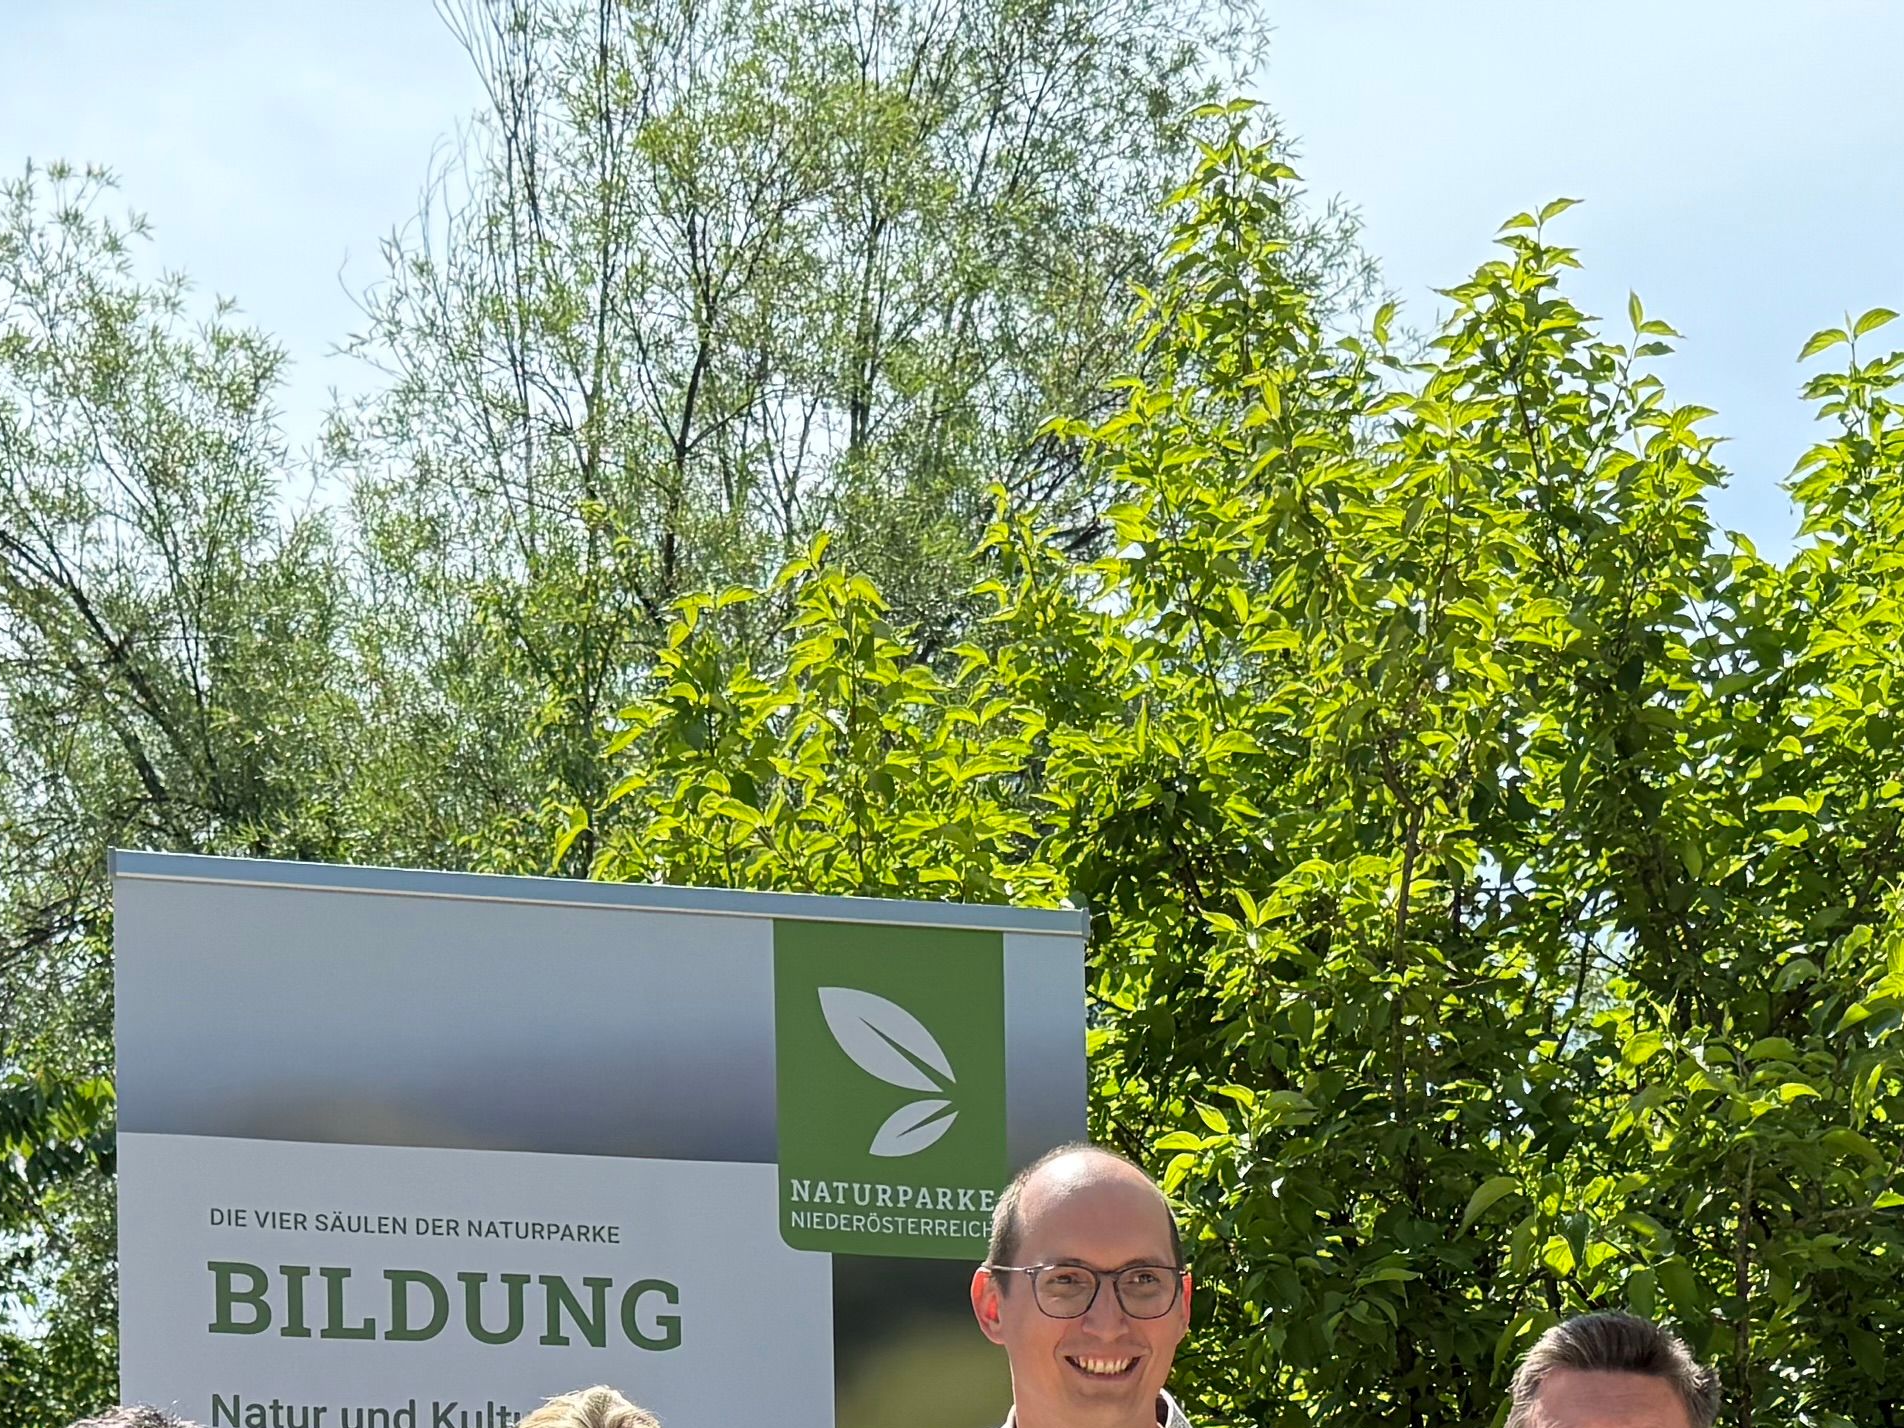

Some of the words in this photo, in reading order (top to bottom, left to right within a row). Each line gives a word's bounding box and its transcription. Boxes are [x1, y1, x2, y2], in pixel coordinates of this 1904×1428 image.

[790, 1179, 995, 1212] NATURPARKE
[209, 1207, 247, 1228] DIE
[254, 1210, 307, 1231] VIER
[315, 1210, 407, 1235] SÄULEN
[415, 1217, 460, 1237] DER
[467, 1219, 621, 1245] NATURPARKE
[207, 1260, 683, 1352] BILDUNG
